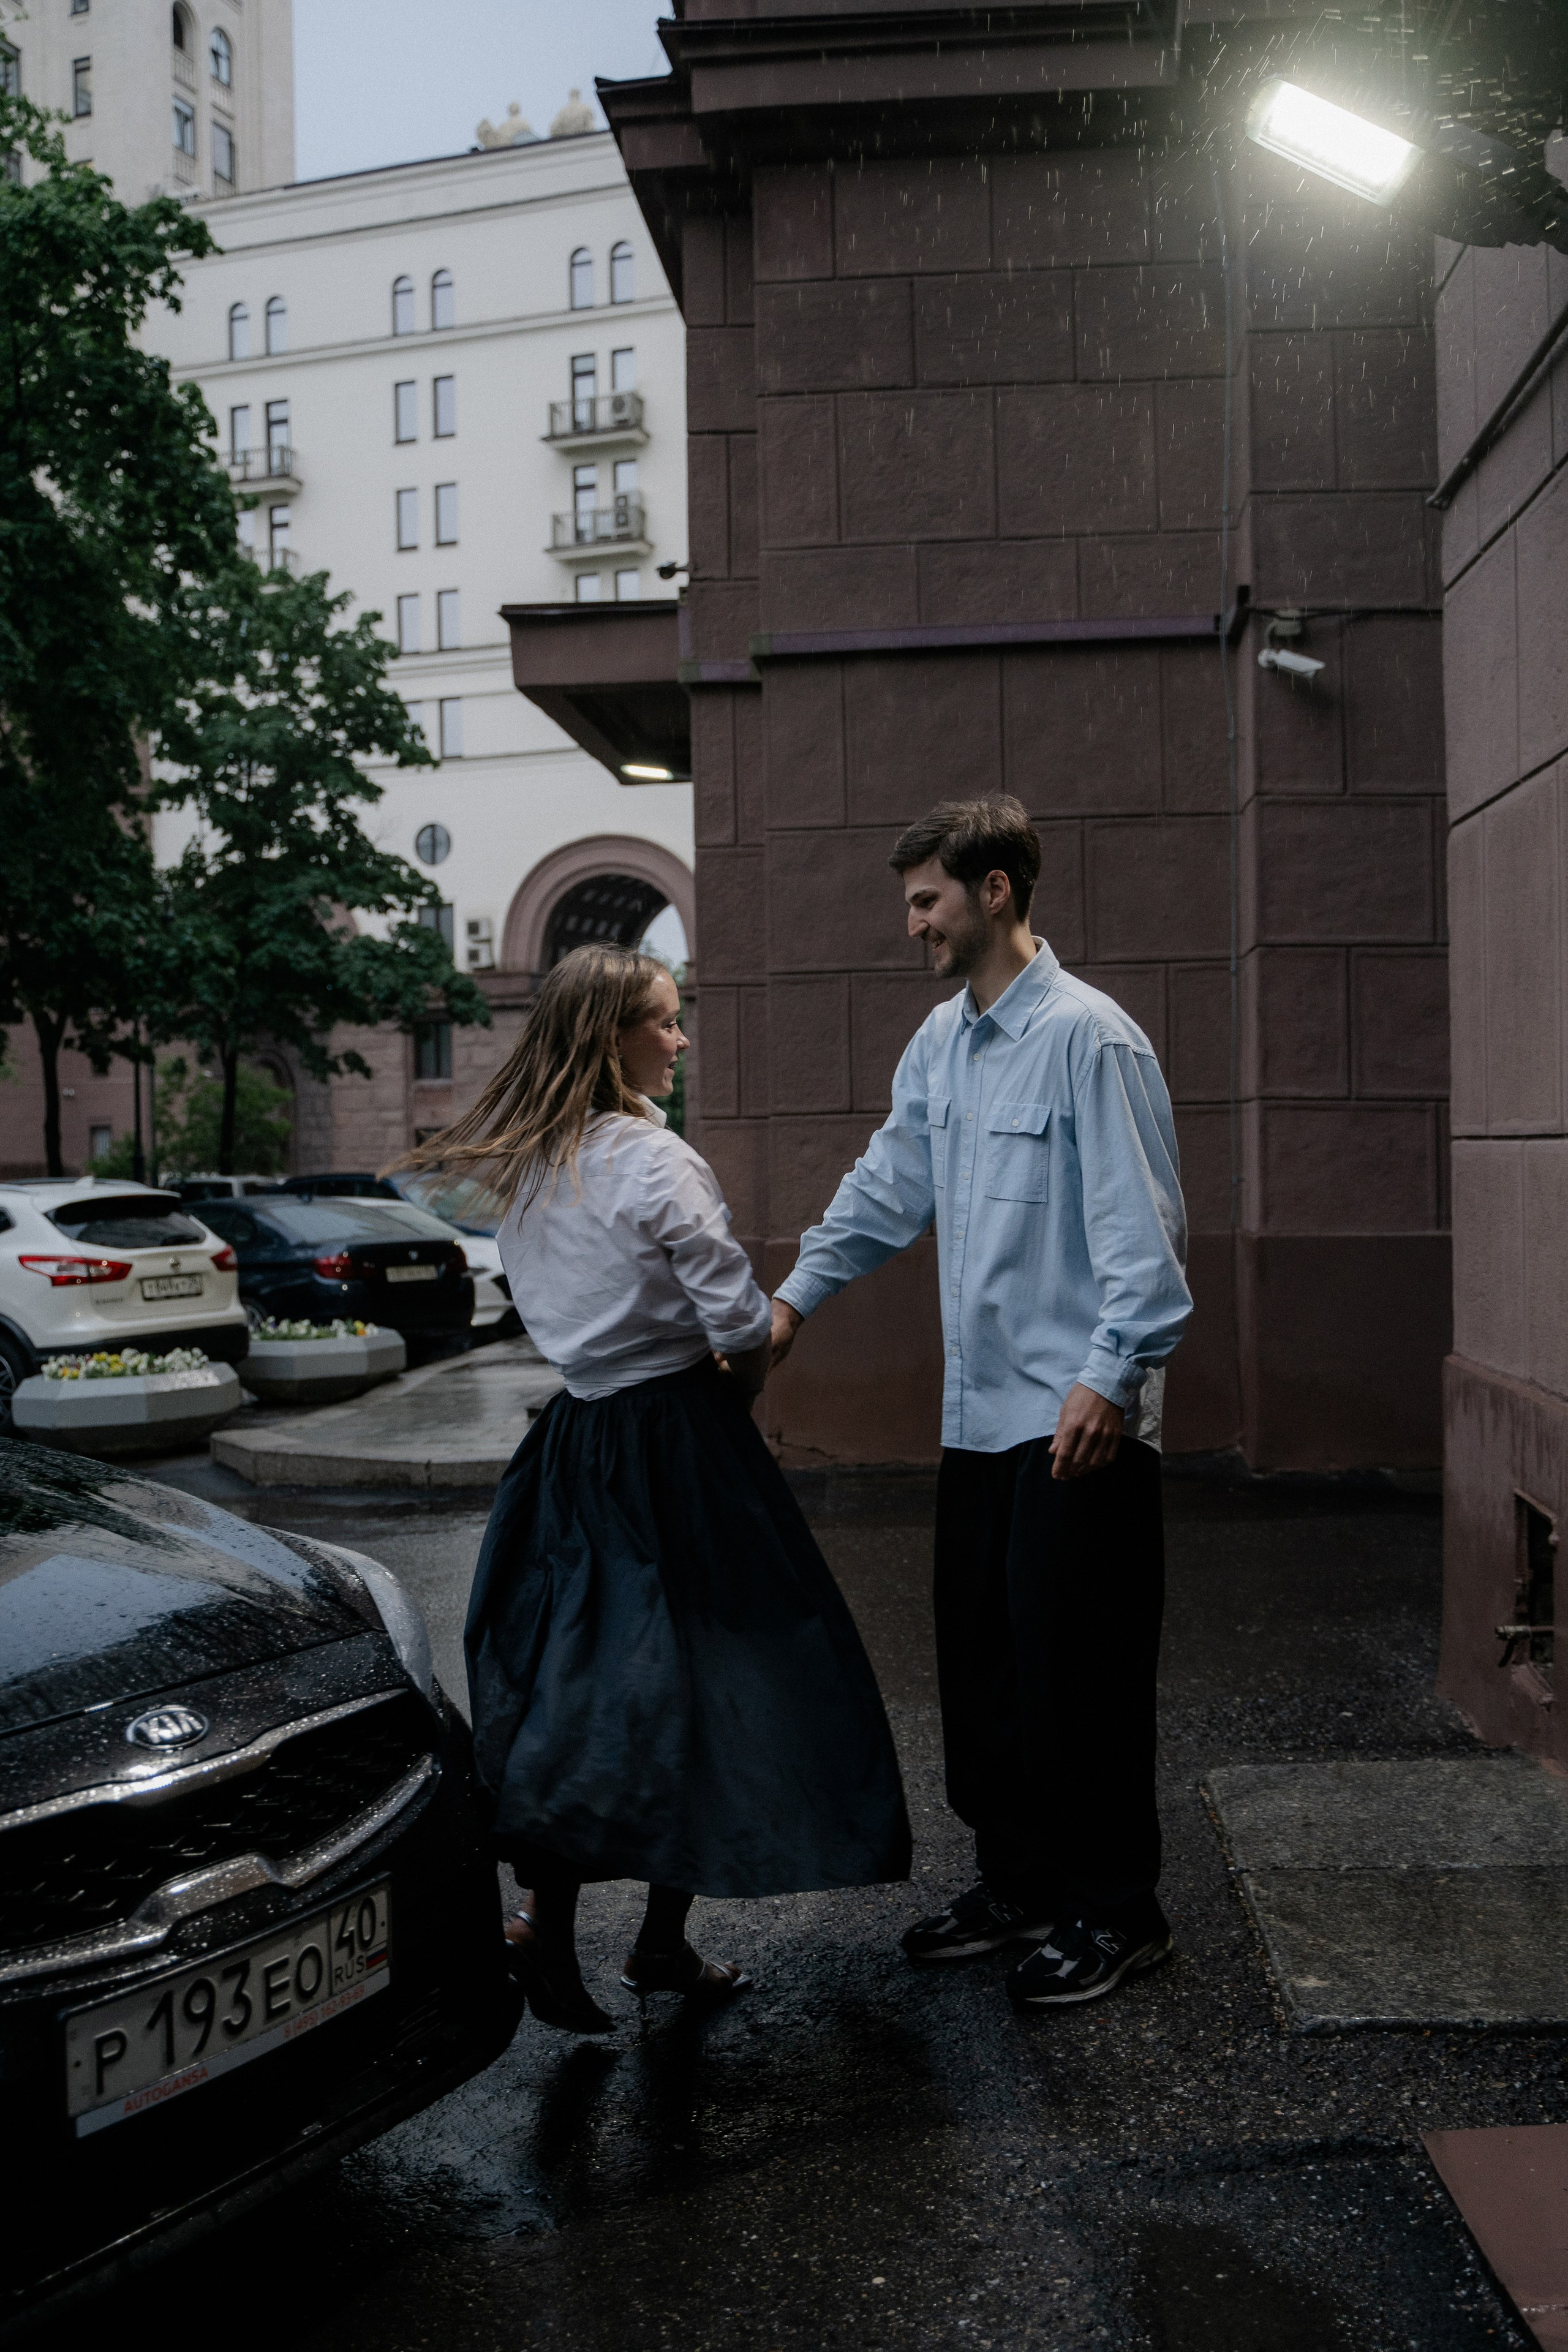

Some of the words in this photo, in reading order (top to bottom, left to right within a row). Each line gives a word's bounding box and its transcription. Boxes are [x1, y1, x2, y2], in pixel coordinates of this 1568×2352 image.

[136, 1713, 203, 1744] KIA
[334, 1896, 377, 1958] 40
[334, 1955, 366, 1986] RUS
